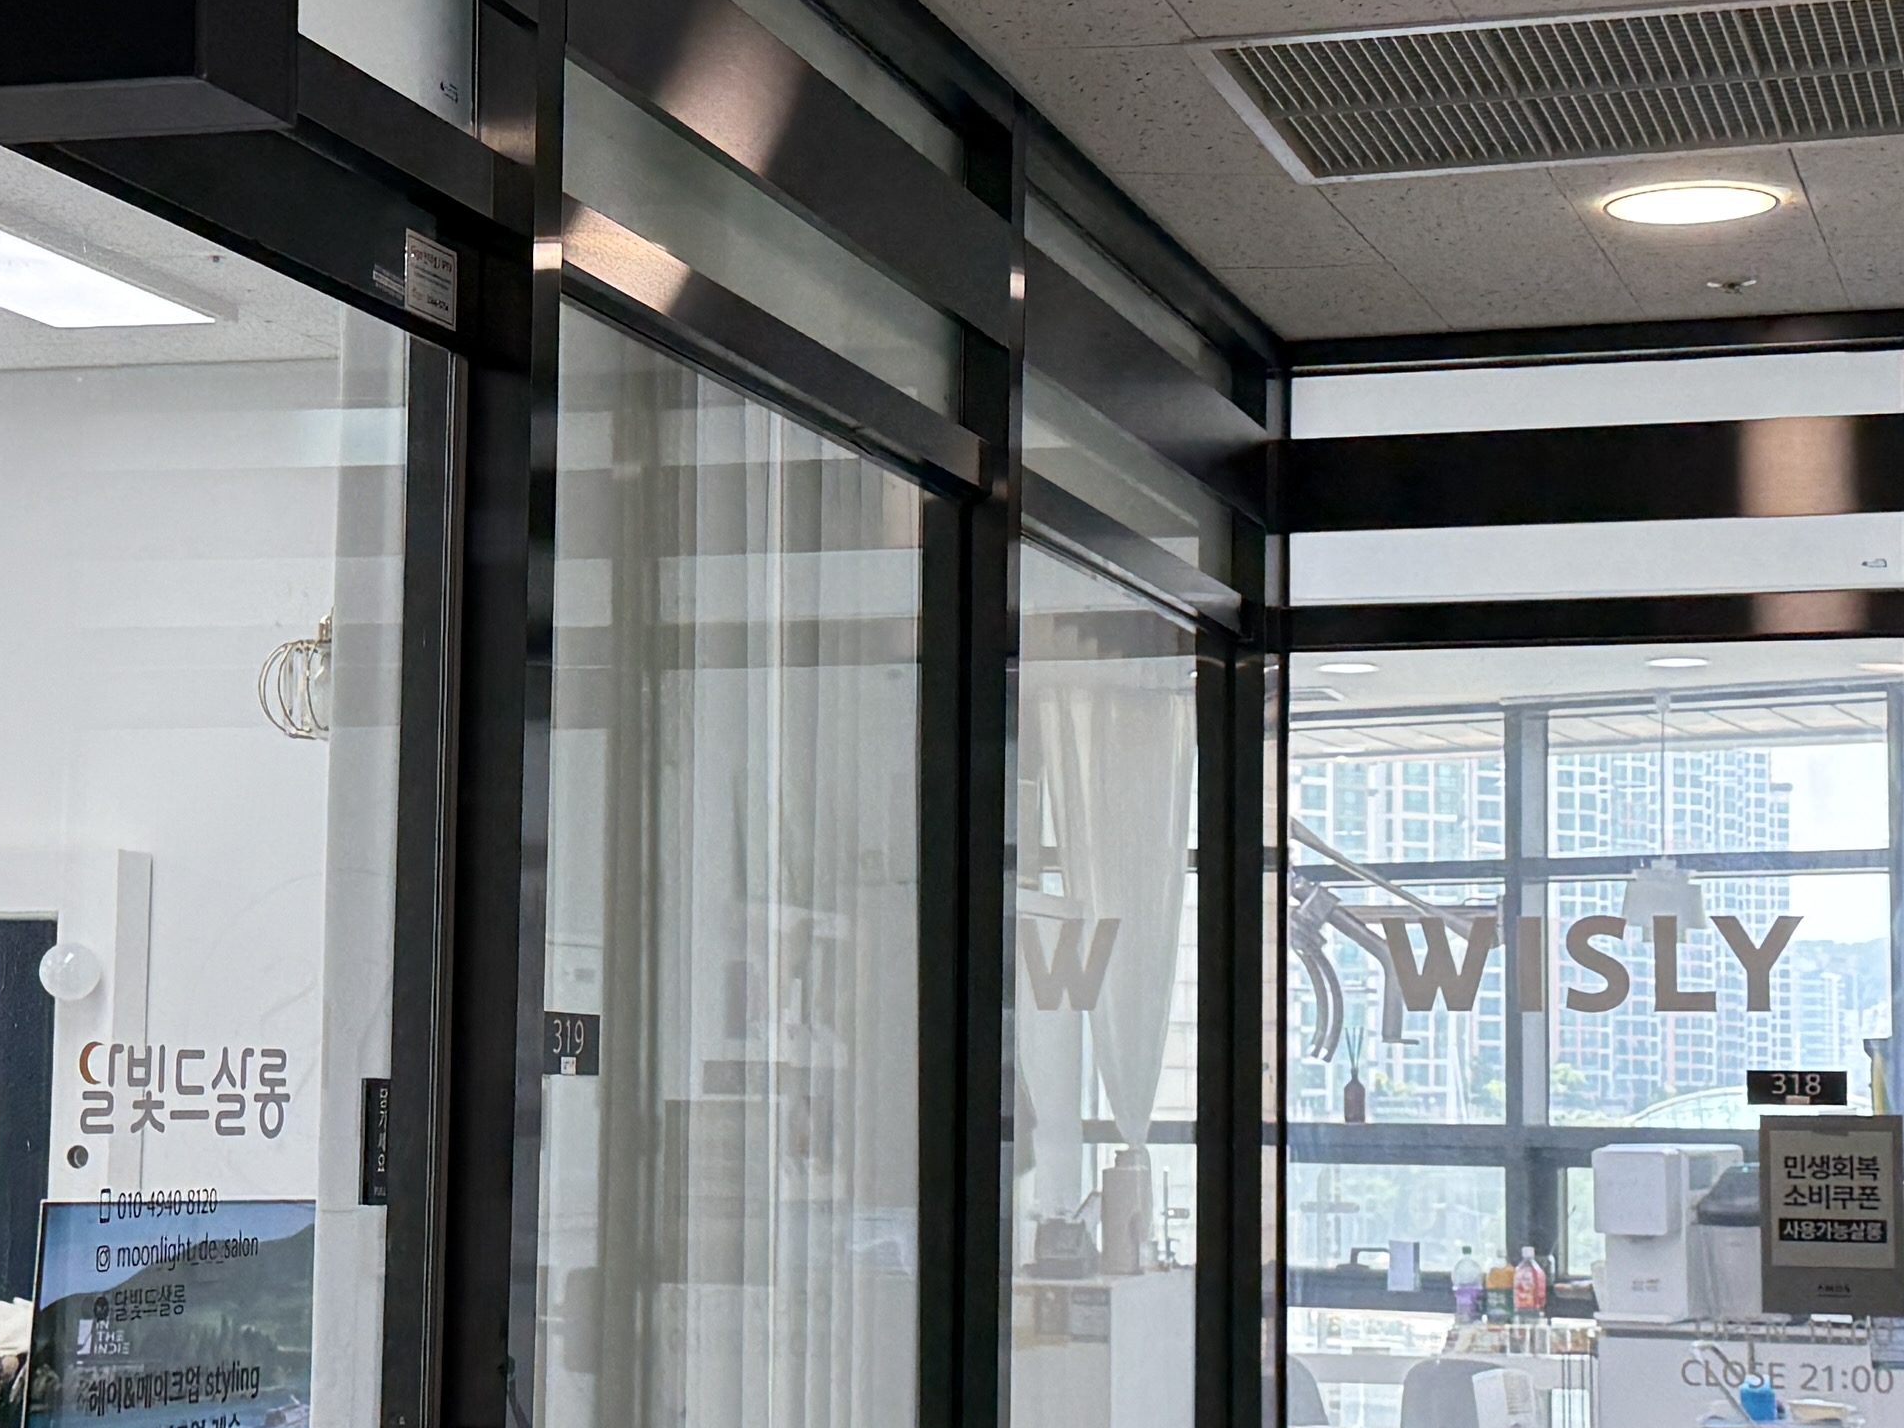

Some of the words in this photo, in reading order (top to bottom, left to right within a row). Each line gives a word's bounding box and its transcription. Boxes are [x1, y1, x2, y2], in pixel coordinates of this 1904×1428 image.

[1381, 913, 1805, 1013] WISLY
[552, 1018, 585, 1055] 319
[78, 1040, 292, 1141] 달빛드살롱
[1771, 1072, 1822, 1096] 318
[1782, 1154, 1881, 1181] 민생회복
[1782, 1183, 1881, 1211] 소비쿠폰
[1782, 1220, 1885, 1242] 사용가능살롱
[205, 1360, 261, 1406] styling
[1799, 1362, 1894, 1395] 21:00
